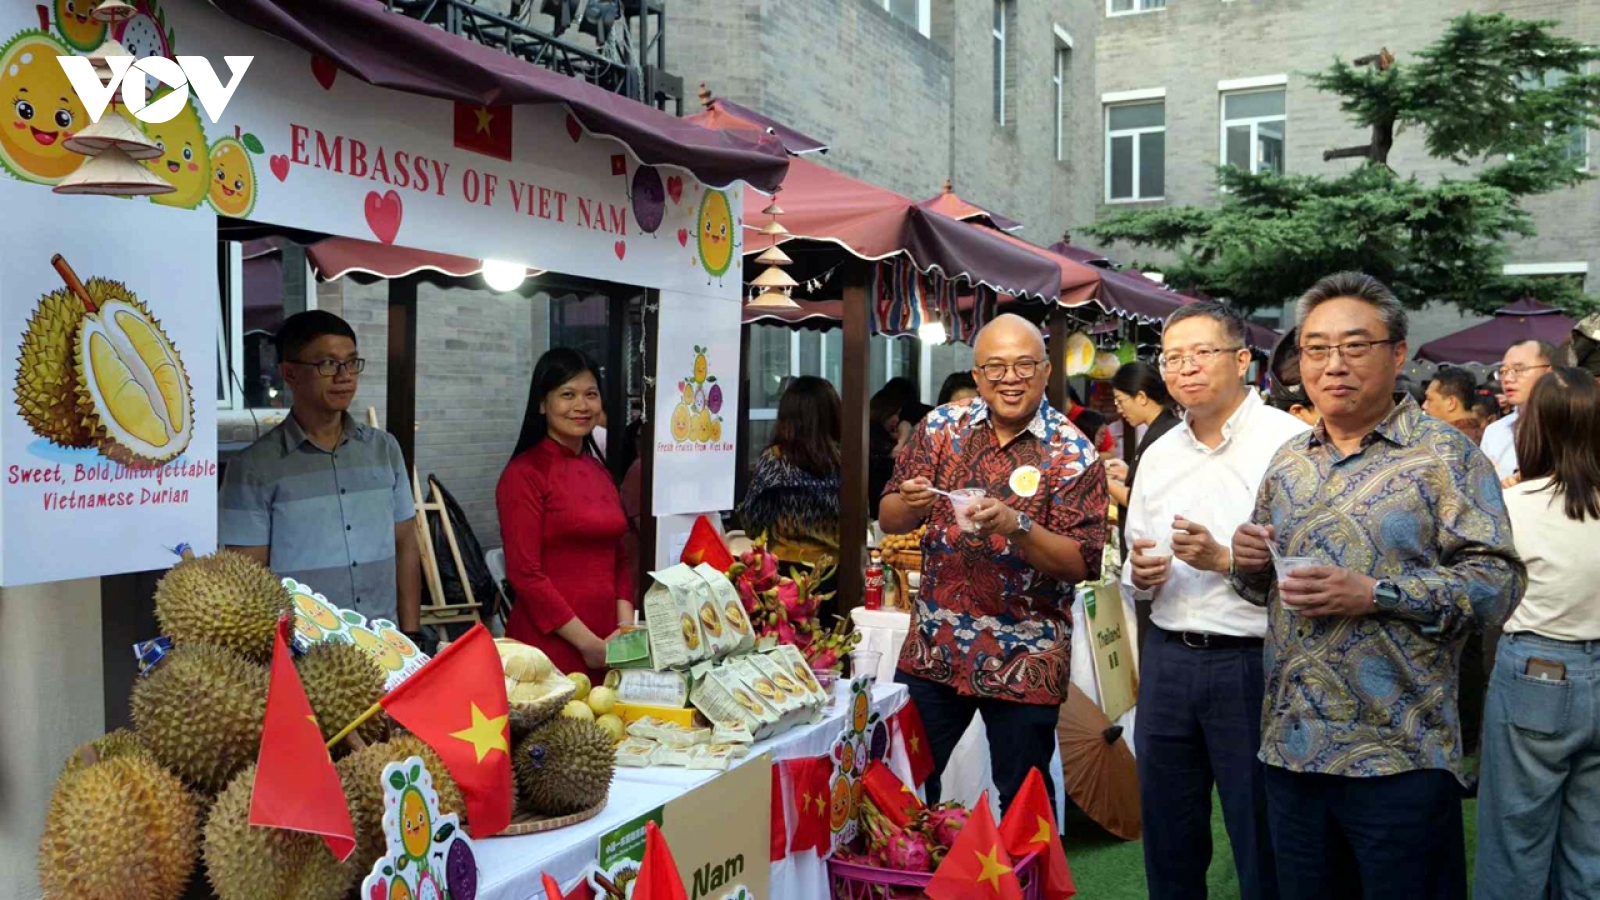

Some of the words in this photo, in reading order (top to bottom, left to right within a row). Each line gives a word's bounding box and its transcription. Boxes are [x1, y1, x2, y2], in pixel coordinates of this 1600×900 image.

[289, 123, 450, 197] EMBASSY
[462, 168, 499, 206] OF
[507, 178, 568, 222] VIET
[576, 196, 627, 236] NAM
[8, 463, 66, 485] Sweet,
[43, 490, 135, 511] Vietnamese
[139, 486, 189, 505] Durian
[691, 853, 744, 900] Nam
